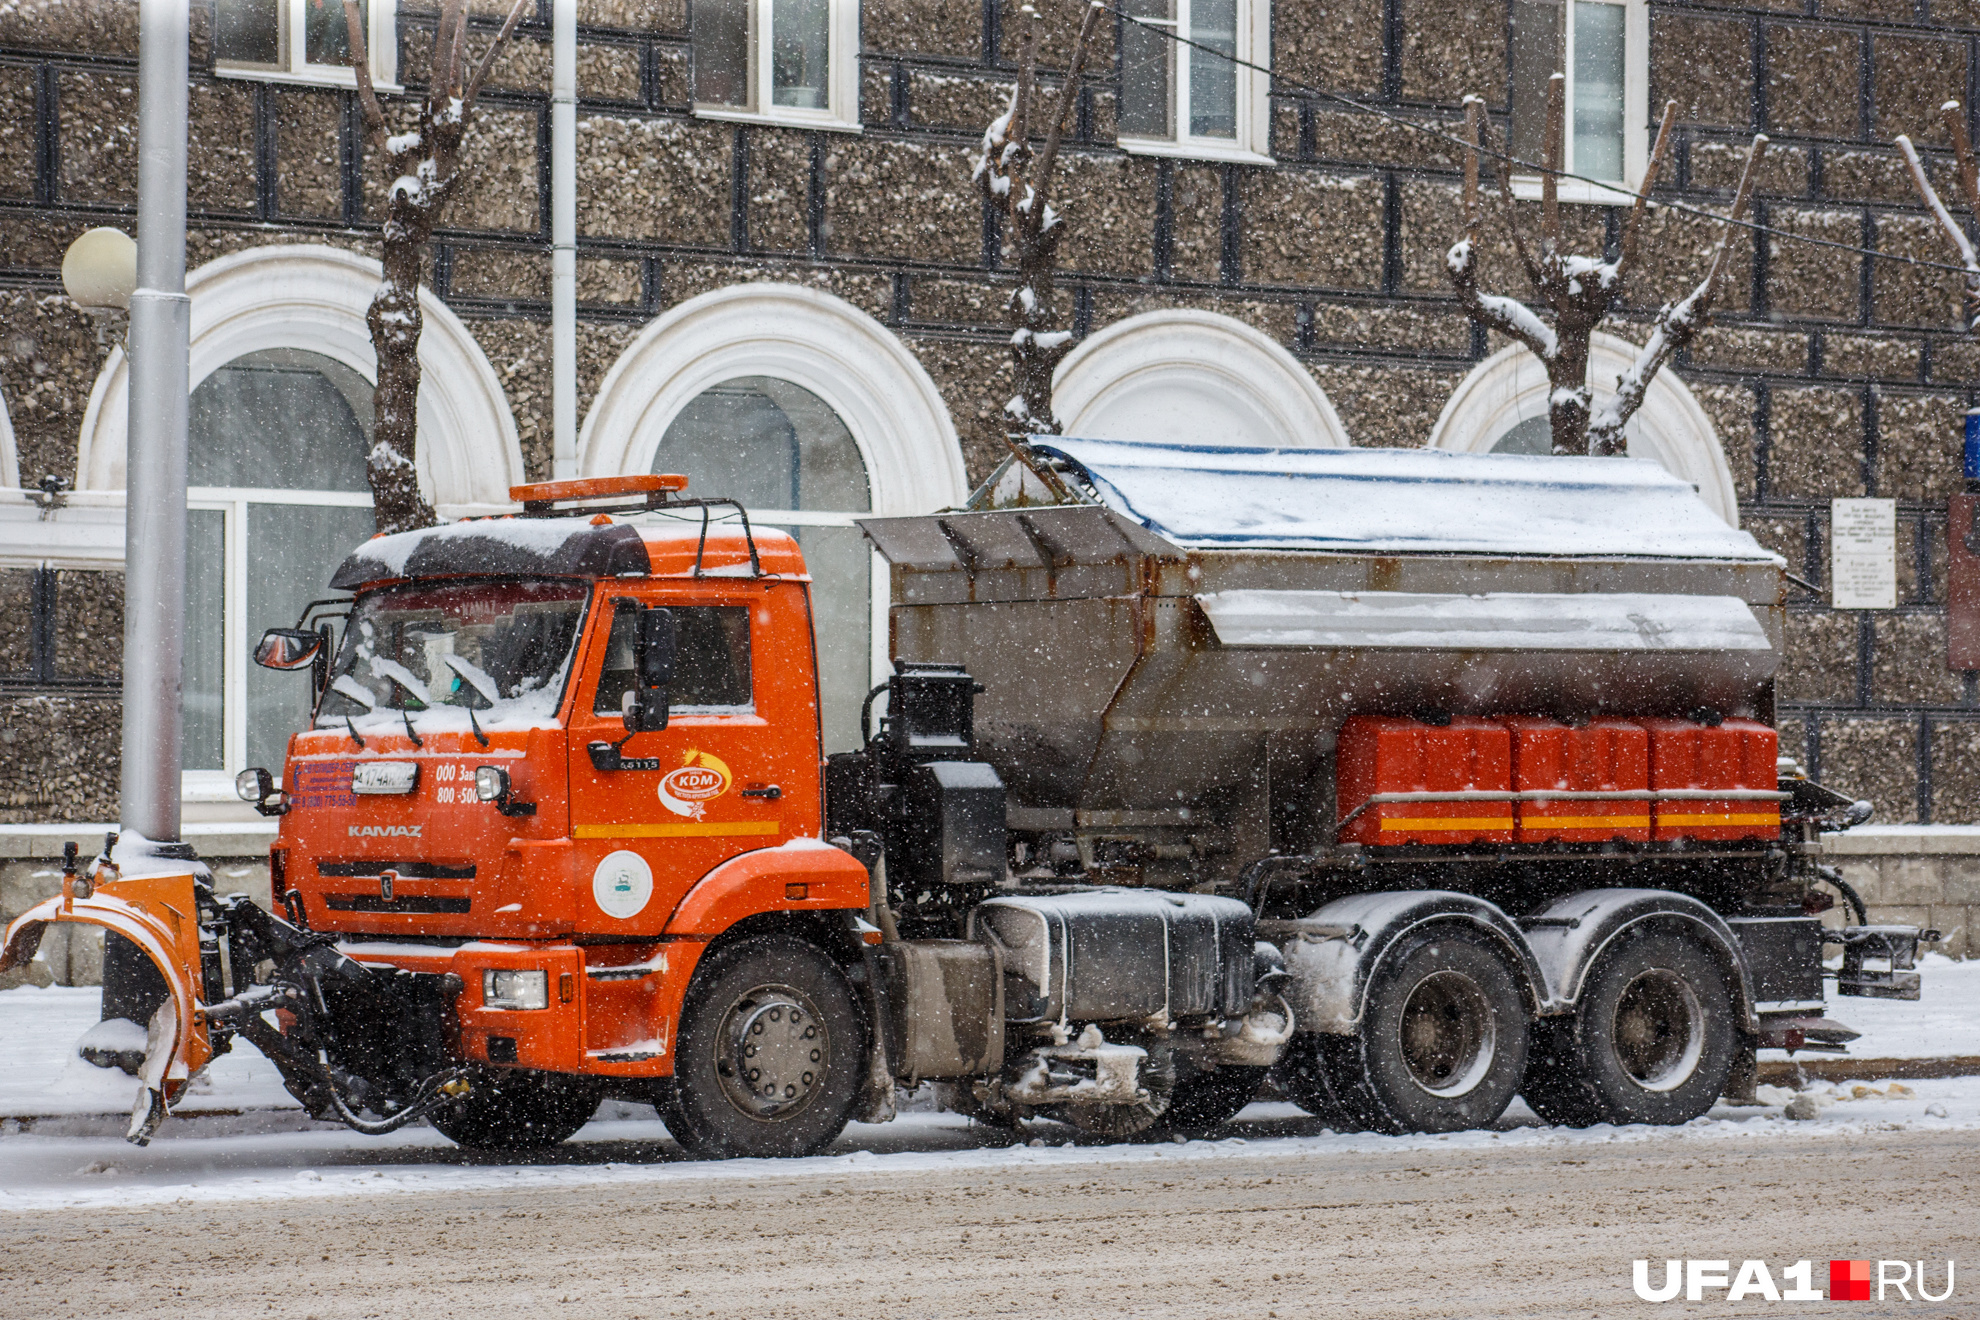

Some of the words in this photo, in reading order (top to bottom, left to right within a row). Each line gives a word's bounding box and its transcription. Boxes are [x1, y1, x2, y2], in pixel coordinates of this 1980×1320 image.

[462, 600, 496, 616] KAMAZ
[436, 764, 456, 781] ООО
[458, 764, 476, 781] Зав
[680, 775, 713, 786] KDM
[437, 787, 455, 803] 800
[348, 825, 422, 837] KAMAZ
